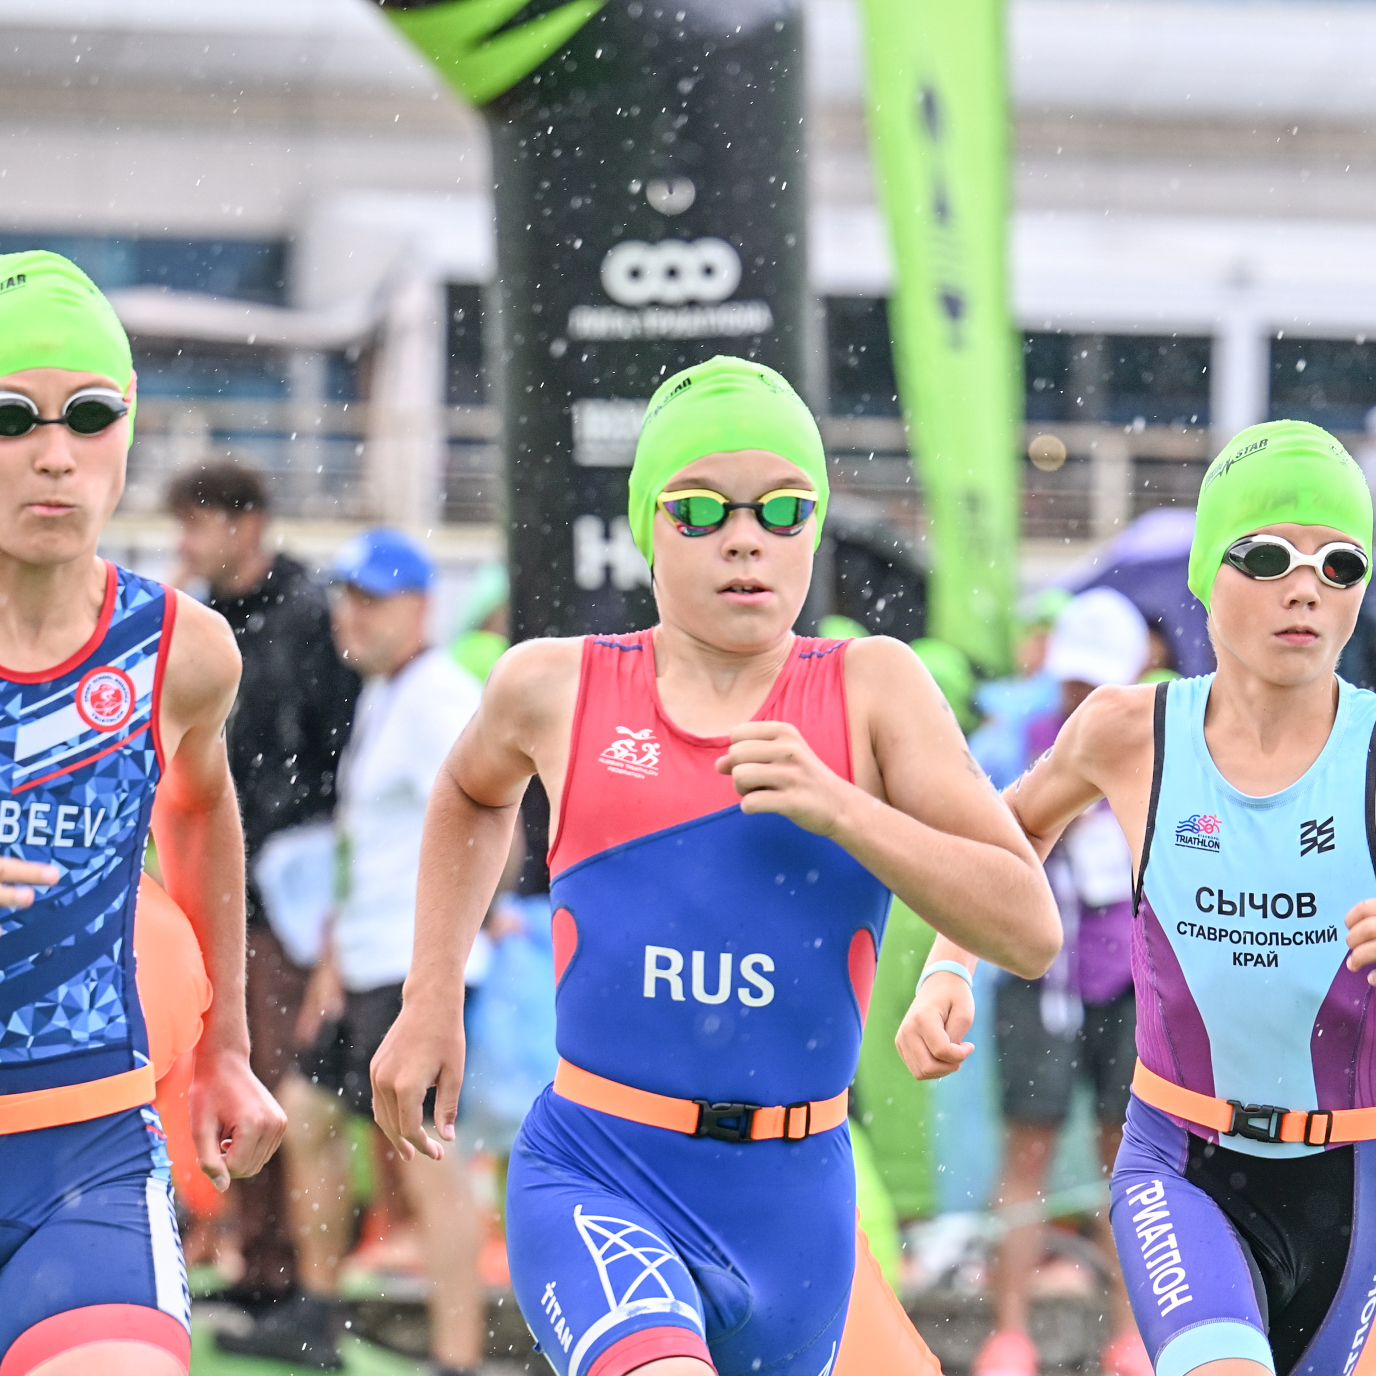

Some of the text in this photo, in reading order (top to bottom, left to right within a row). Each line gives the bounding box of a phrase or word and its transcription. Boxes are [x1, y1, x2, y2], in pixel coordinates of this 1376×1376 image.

[1175, 834, 1220, 850] TRIATHLON
[1195, 886, 1318, 920] СЫЧОВ
[1176, 920, 1338, 947] СТАВРОПОЛЬСКИЙ
[643, 945, 776, 1007] RUS
[1232, 950, 1279, 968] КРАЙ
[1125, 1179, 1193, 1317] ТРИАТЛОН
[541, 1281, 573, 1353] TITAN
